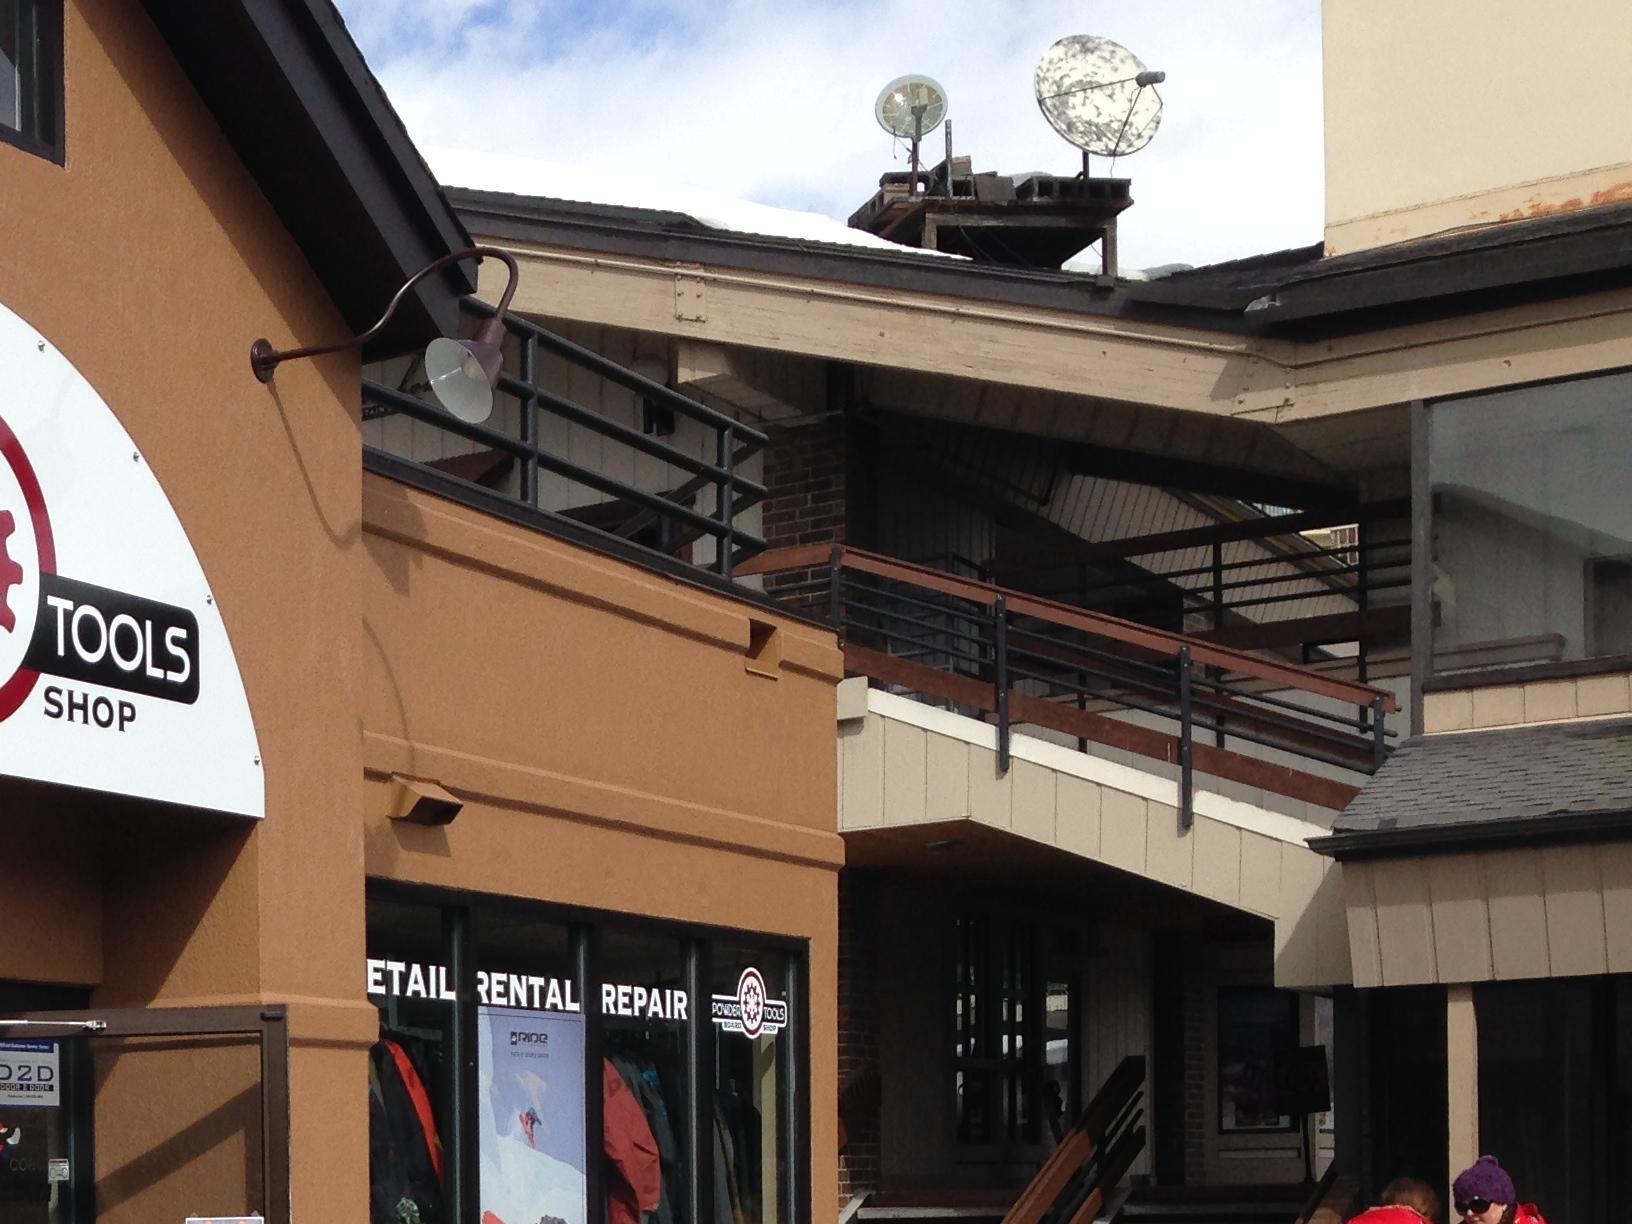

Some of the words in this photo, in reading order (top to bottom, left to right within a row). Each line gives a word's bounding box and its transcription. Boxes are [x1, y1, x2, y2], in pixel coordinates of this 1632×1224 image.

[47, 595, 191, 683] TOOLS
[43, 686, 137, 732] SHOP
[367, 959, 456, 1000] ETAIL
[477, 971, 580, 1012] RENTAL
[602, 983, 688, 1020] REPAIR
[712, 1002, 742, 1017] POWDER
[763, 1006, 785, 1021] TOOLS
[517, 1032, 548, 1044] RIDE
[763, 1024, 777, 1032] SHOP
